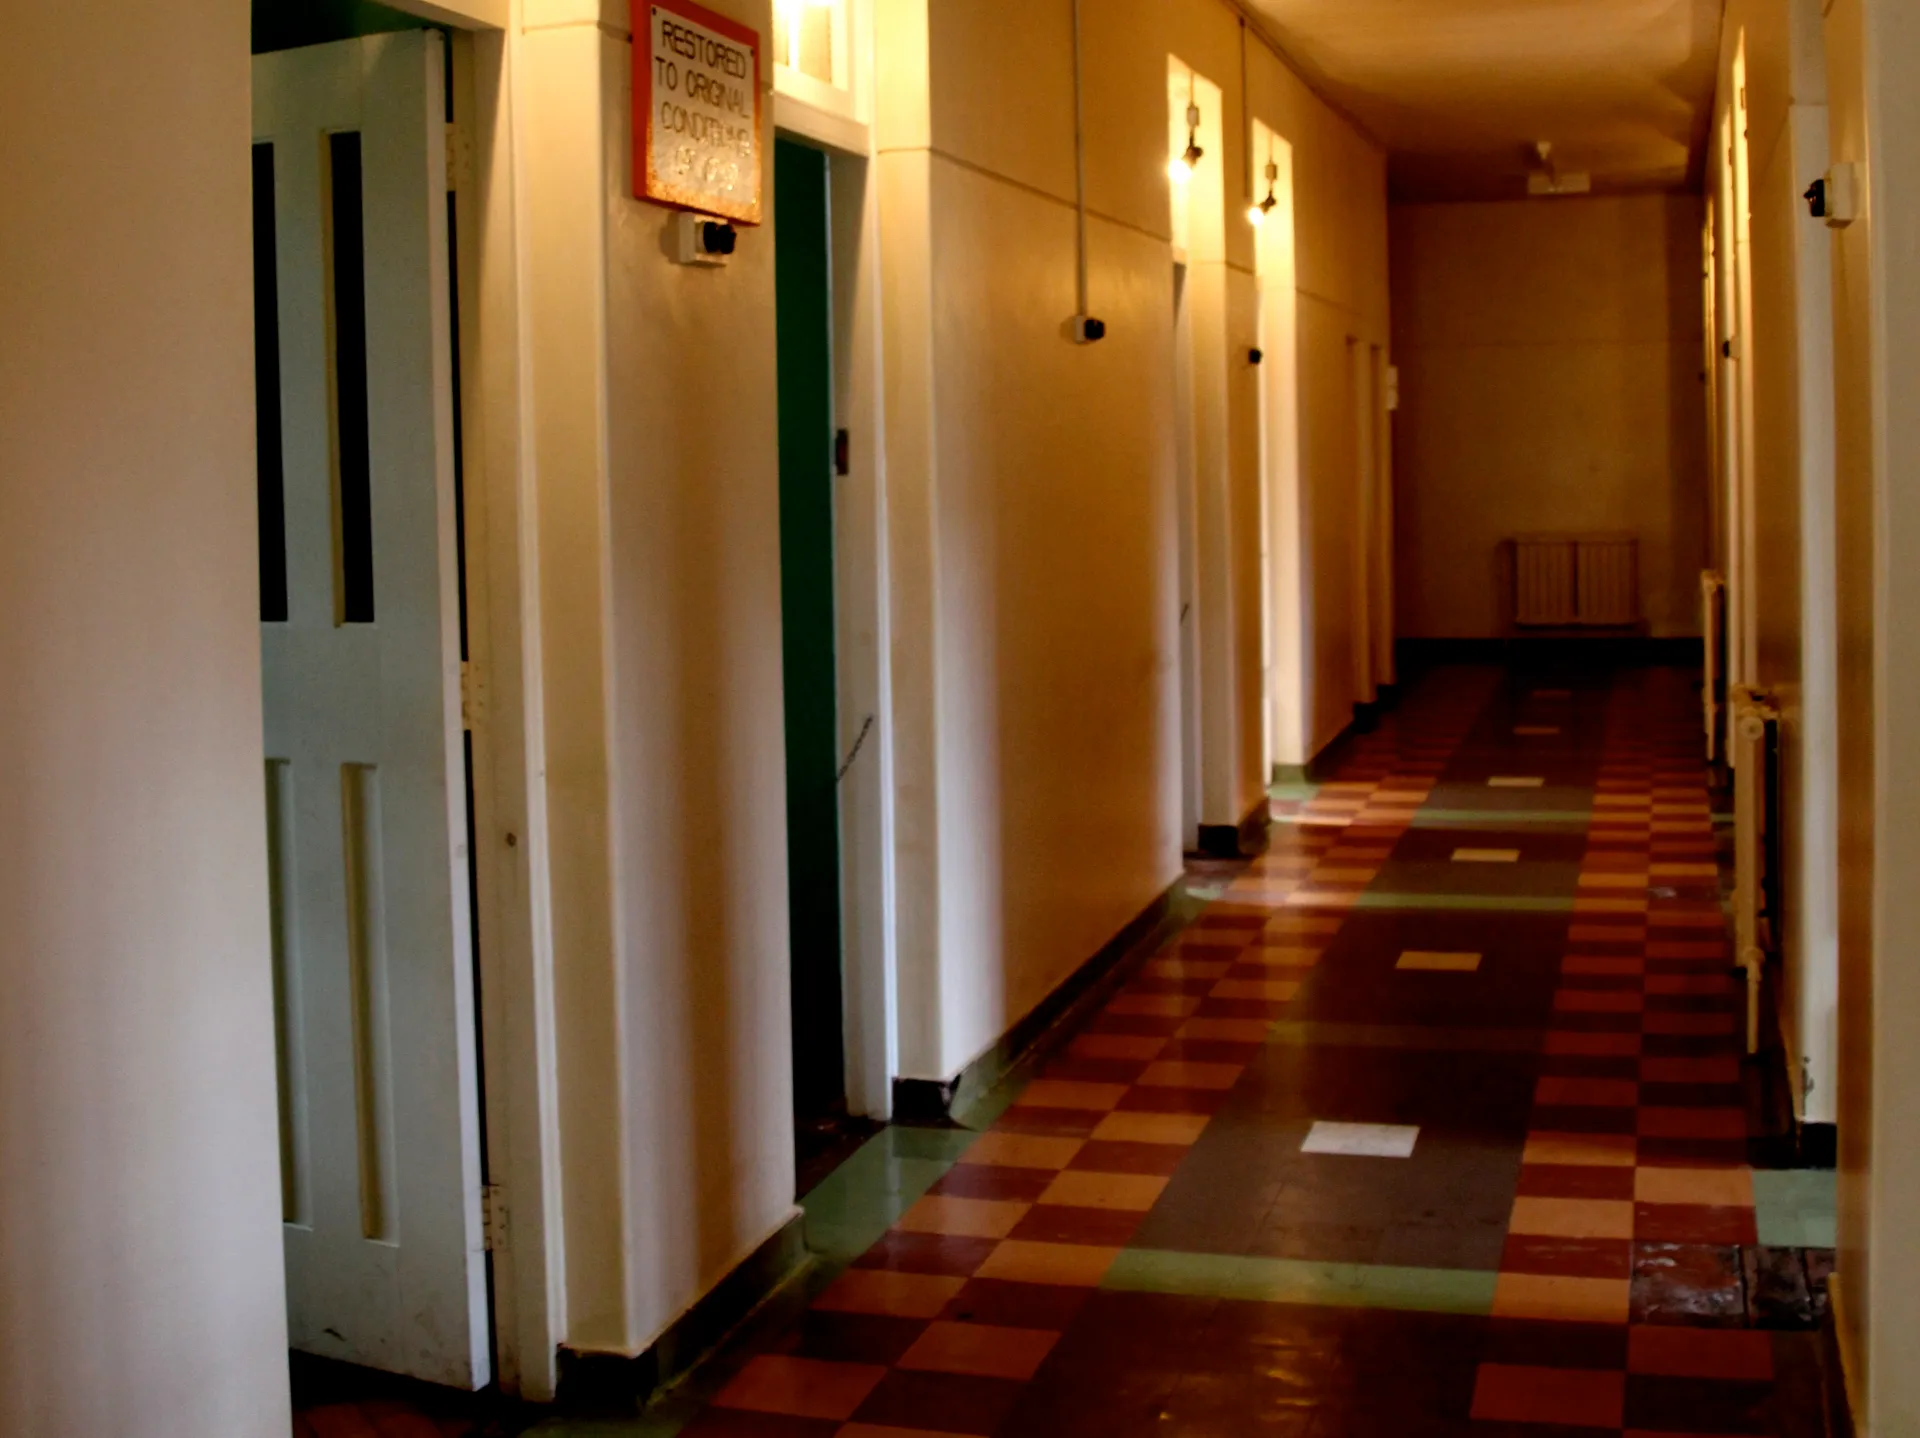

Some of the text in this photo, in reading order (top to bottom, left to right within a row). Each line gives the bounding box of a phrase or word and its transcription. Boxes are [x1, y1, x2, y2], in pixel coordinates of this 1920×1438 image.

[662, 20, 746, 79] RESTORED
[655, 56, 750, 119] TO ORIGINAL
